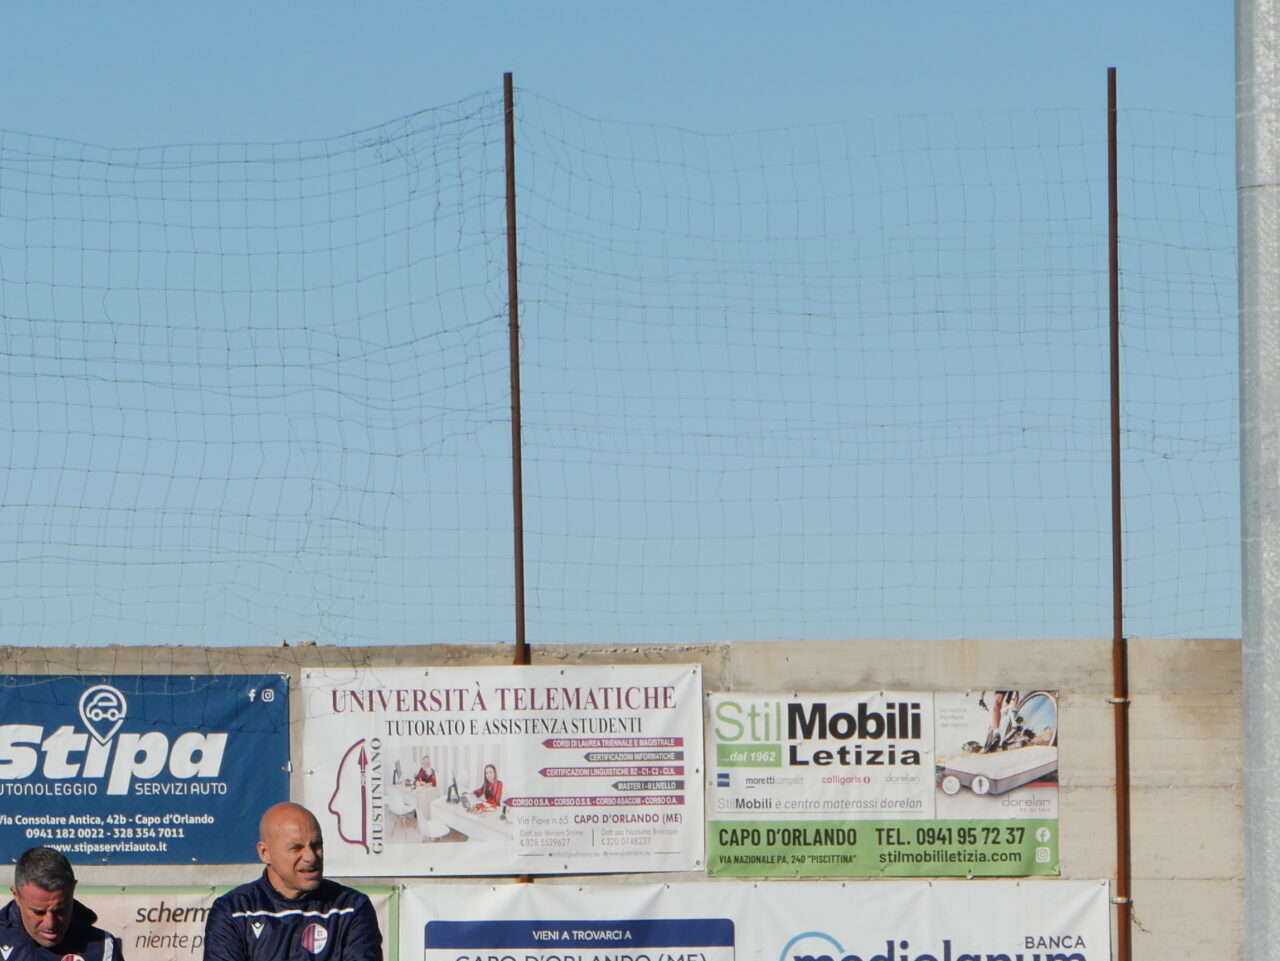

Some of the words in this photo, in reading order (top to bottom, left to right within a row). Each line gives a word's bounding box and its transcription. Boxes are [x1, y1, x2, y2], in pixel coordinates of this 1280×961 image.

[331, 682, 487, 713] UNIVERSITÀ
[495, 686, 677, 711] TELEMATICHE
[385, 719, 465, 736] TUTORATO
[470, 719, 479, 735] E
[482, 718, 568, 735] ASSISTENZA
[571, 717, 642, 734] STUDENTI
[552, 740, 570, 748] CORSI
[602, 739, 632, 747] TRIENNALE
[639, 738, 675, 746] MAGISTRALE
[589, 753, 633, 761] CERTIFICAZIONI
[634, 752, 675, 760] INFORMATICHE
[750, 751, 776, 761] 1962
[789, 744, 920, 766] Letizia
[546, 768, 589, 776] CERTIFICAZIONI
[885, 772, 920, 783] dorelan
[618, 782, 641, 790] MASTER
[745, 775, 775, 785] moretti
[821, 774, 862, 787] calligaris
[135, 783, 187, 795] SERVIZI
[191, 782, 227, 795] AUTO
[370, 737, 384, 854] GIUSTINIANO
[645, 797, 666, 805] CORSO
[1001, 794, 1051, 807] dorelan
[784, 798, 819, 809] centro
[822, 797, 878, 809] materassi
[880, 797, 923, 809] dorelan
[15, 815, 66, 825] Consolare
[69, 814, 104, 826] Antica,
[106, 814, 126, 825] 42b
[135, 815, 161, 827] Capo
[163, 814, 214, 825] d'Orlando
[517, 816, 530, 825] Via
[532, 816, 550, 825] Piave
[574, 814, 600, 825] CAPO
[602, 813, 660, 824] D'ORLANDO
[662, 812, 683, 825] (ME)
[26, 829, 53, 839] 0941
[56, 829, 75, 838] 182
[77, 829, 104, 838] 0022
[113, 829, 133, 838] 328
[136, 829, 156, 838] 354
[158, 828, 184, 838] 7011
[719, 828, 761, 846] CAPO
[766, 827, 857, 846] D'ORLANDO
[875, 827, 911, 846] TEL.
[916, 827, 952, 846] 0941
[957, 827, 977, 846] 95
[981, 827, 1001, 845] 72
[1005, 827, 1025, 845] 37
[719, 855, 732, 864] VIA
[733, 855, 776, 864] NAZIONALE
[791, 855, 806, 864] 240
[807, 854, 857, 864] "PISCITTINA"
[879, 850, 1022, 863] stilmobililetizia.com
[136, 930, 188, 949] niente
[532, 931, 559, 941] VIENI
[561, 930, 570, 940] A
[572, 930, 621, 940] TROVARCI
[623, 930, 632, 940] A
[1024, 935, 1086, 949] BANCA
